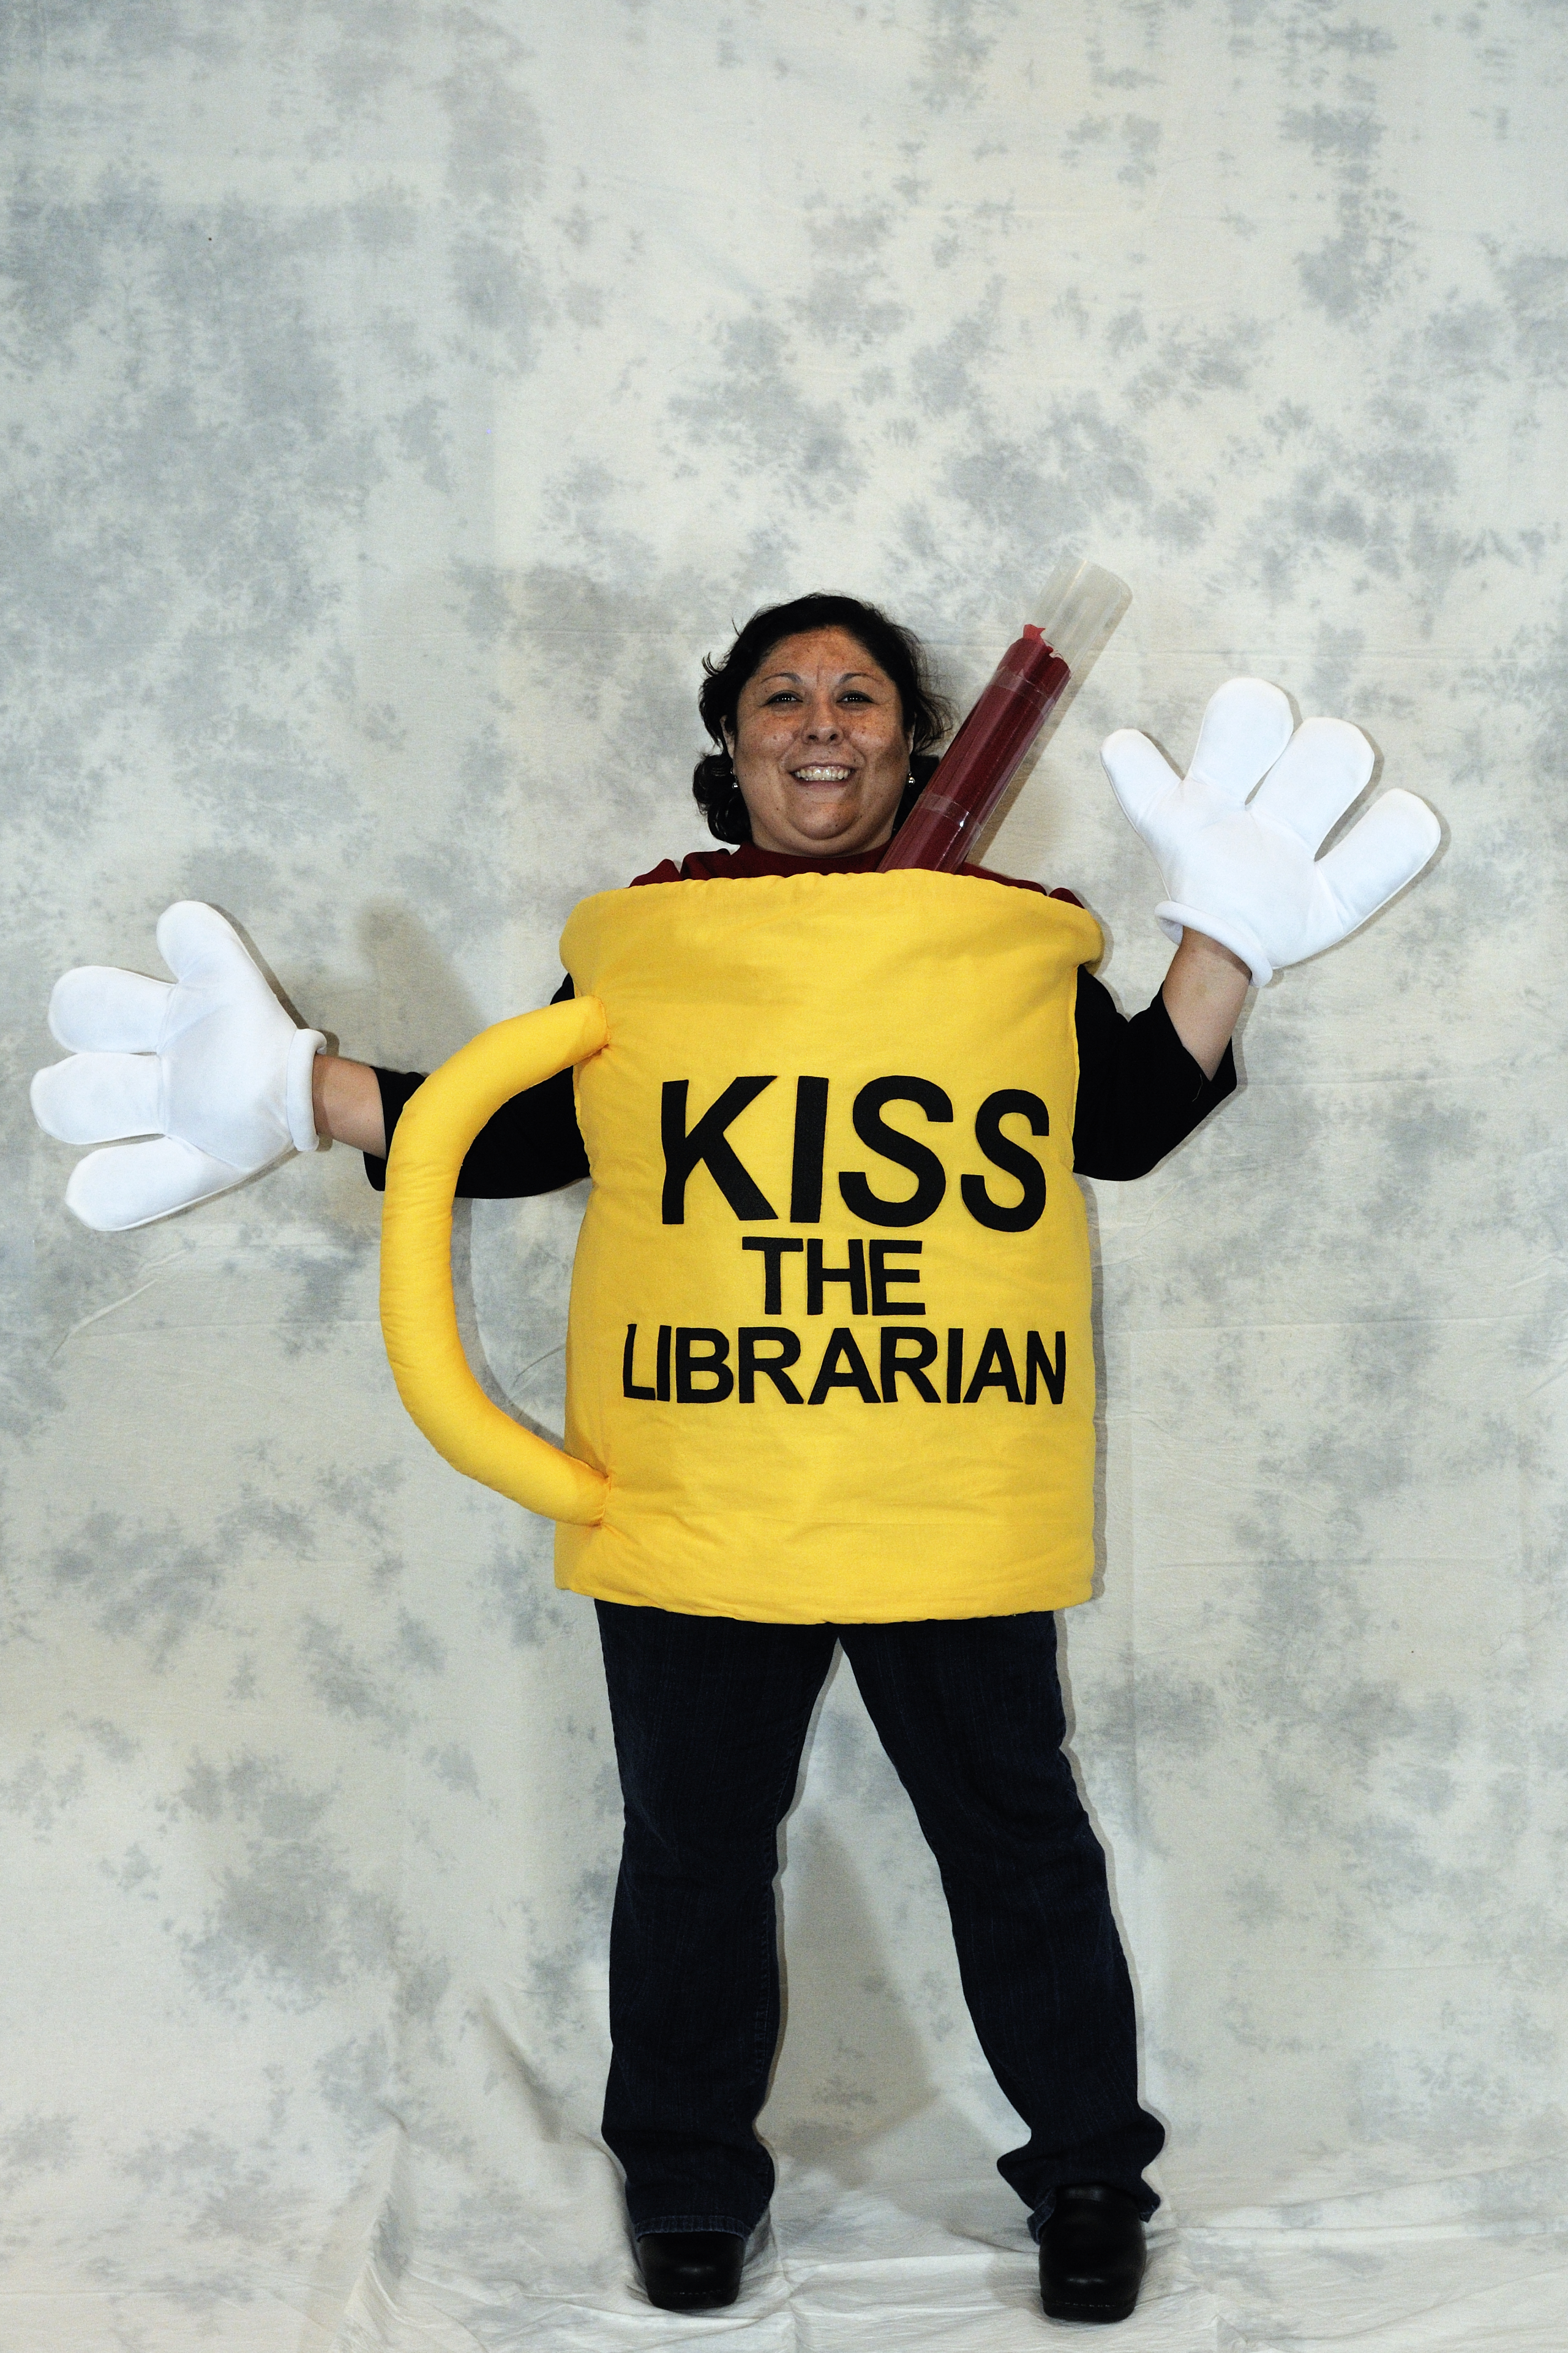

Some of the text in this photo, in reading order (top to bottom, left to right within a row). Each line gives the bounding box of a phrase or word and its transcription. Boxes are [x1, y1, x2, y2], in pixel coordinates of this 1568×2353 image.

[661, 1075, 1049, 1233] KISS
[741, 1236, 926, 1316] THE
[622, 1323, 1067, 1406] LIBRARIAN
